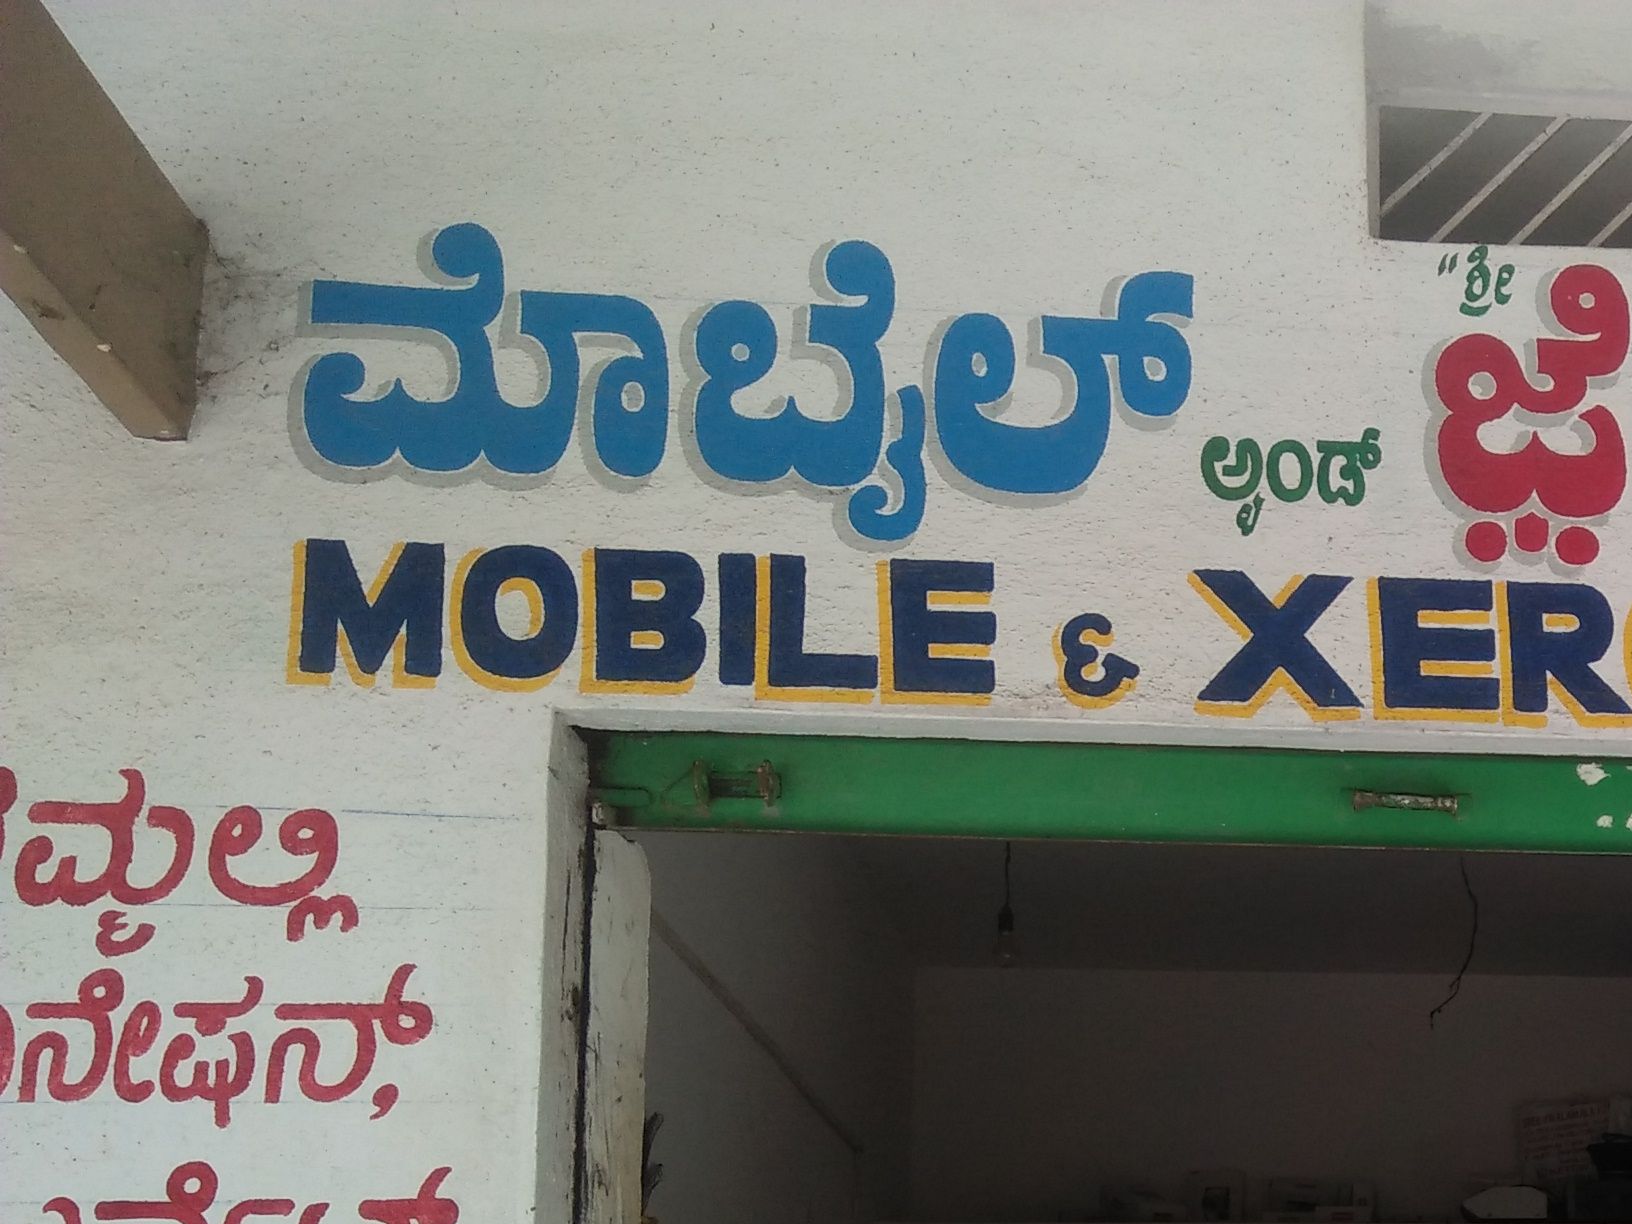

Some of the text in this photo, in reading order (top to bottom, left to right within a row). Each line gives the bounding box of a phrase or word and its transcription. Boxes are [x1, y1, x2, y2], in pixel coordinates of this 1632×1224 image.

[285, 536, 997, 707] MOBILE
[1052, 612, 1140, 704] &
[0, 767, 360, 957] ಮ್ಮಲ್ಲಿ
[0, 963, 434, 1128] ನೇಷನ್,
